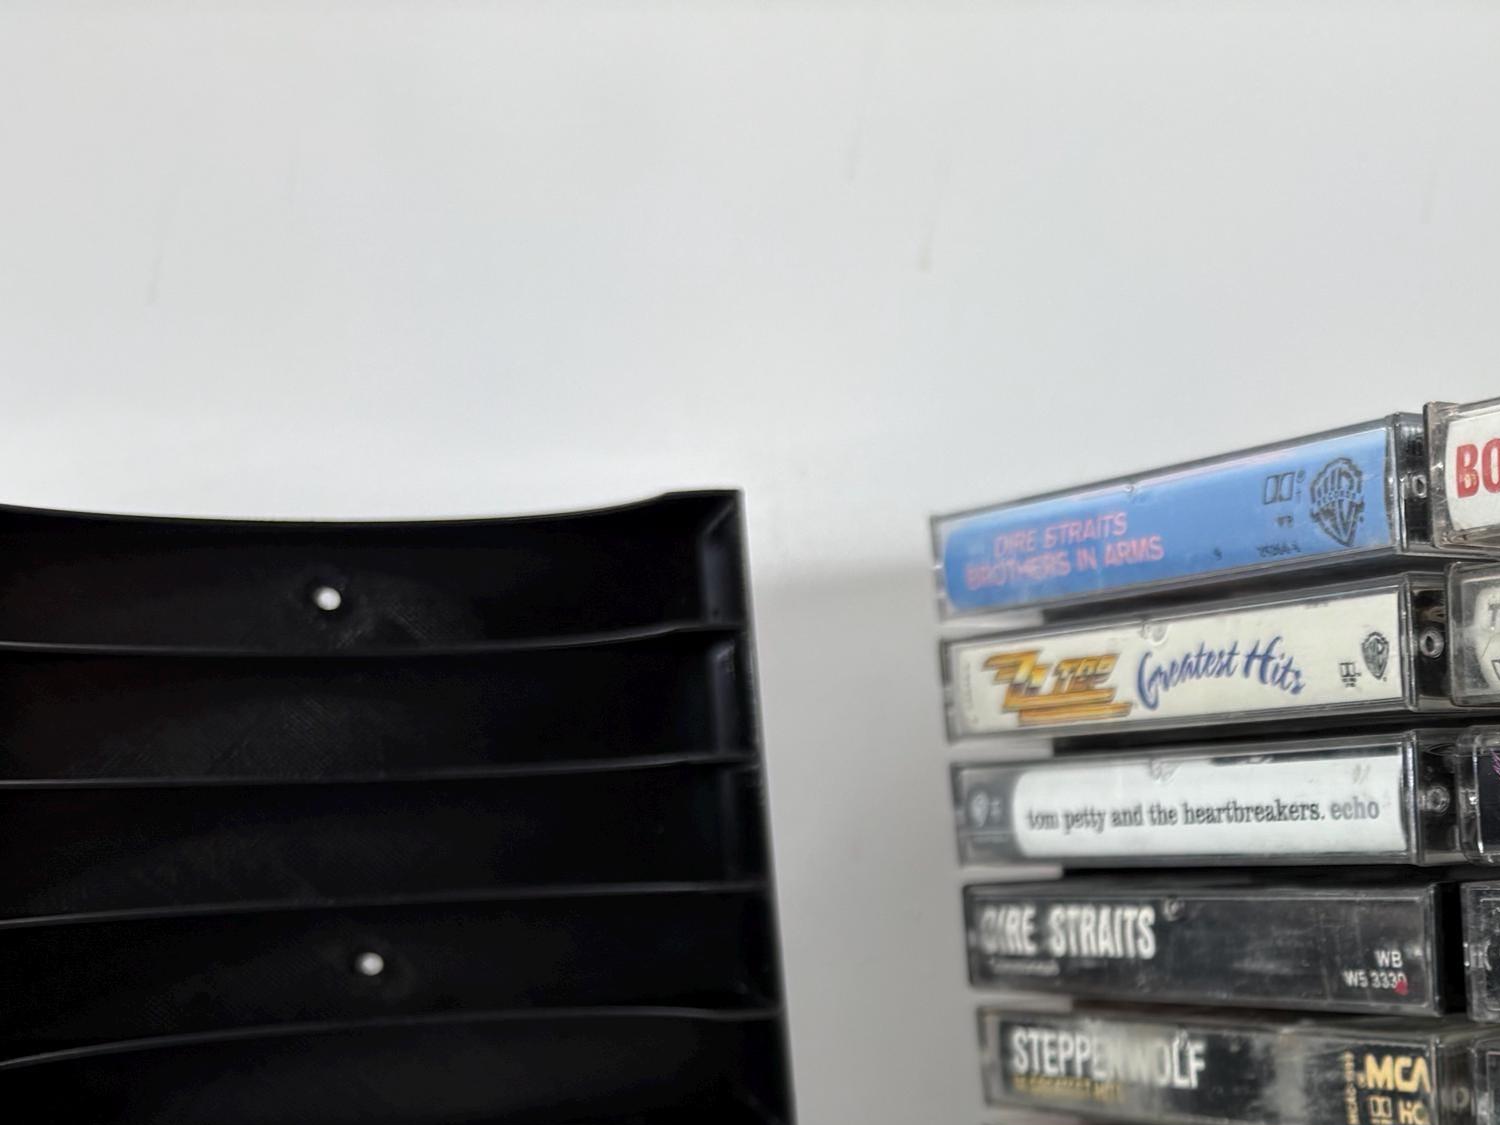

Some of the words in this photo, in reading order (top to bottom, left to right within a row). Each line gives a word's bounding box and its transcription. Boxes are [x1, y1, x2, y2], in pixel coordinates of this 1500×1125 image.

[994, 529, 1037, 557] DIRE
[1043, 511, 1128, 548] STRAITS
[965, 551, 1071, 591] BROTHERS
[1076, 548, 1098, 571] IN
[1104, 535, 1165, 567] ARMS
[1137, 641, 1240, 710] Greatest
[1243, 636, 1305, 695] Hits
[1026, 808, 1059, 830] tom
[1063, 805, 1105, 834] petty
[1111, 805, 1143, 828] and
[1149, 804, 1177, 826] the
[1330, 797, 1380, 821] echo
[981, 905, 1038, 956] DIRE
[1050, 904, 1156, 960] STRAITS
[1374, 950, 1403, 968] WB
[1012, 1027, 1206, 1089] STEPPENWOLF
[1363, 1053, 1431, 1094] MCA
